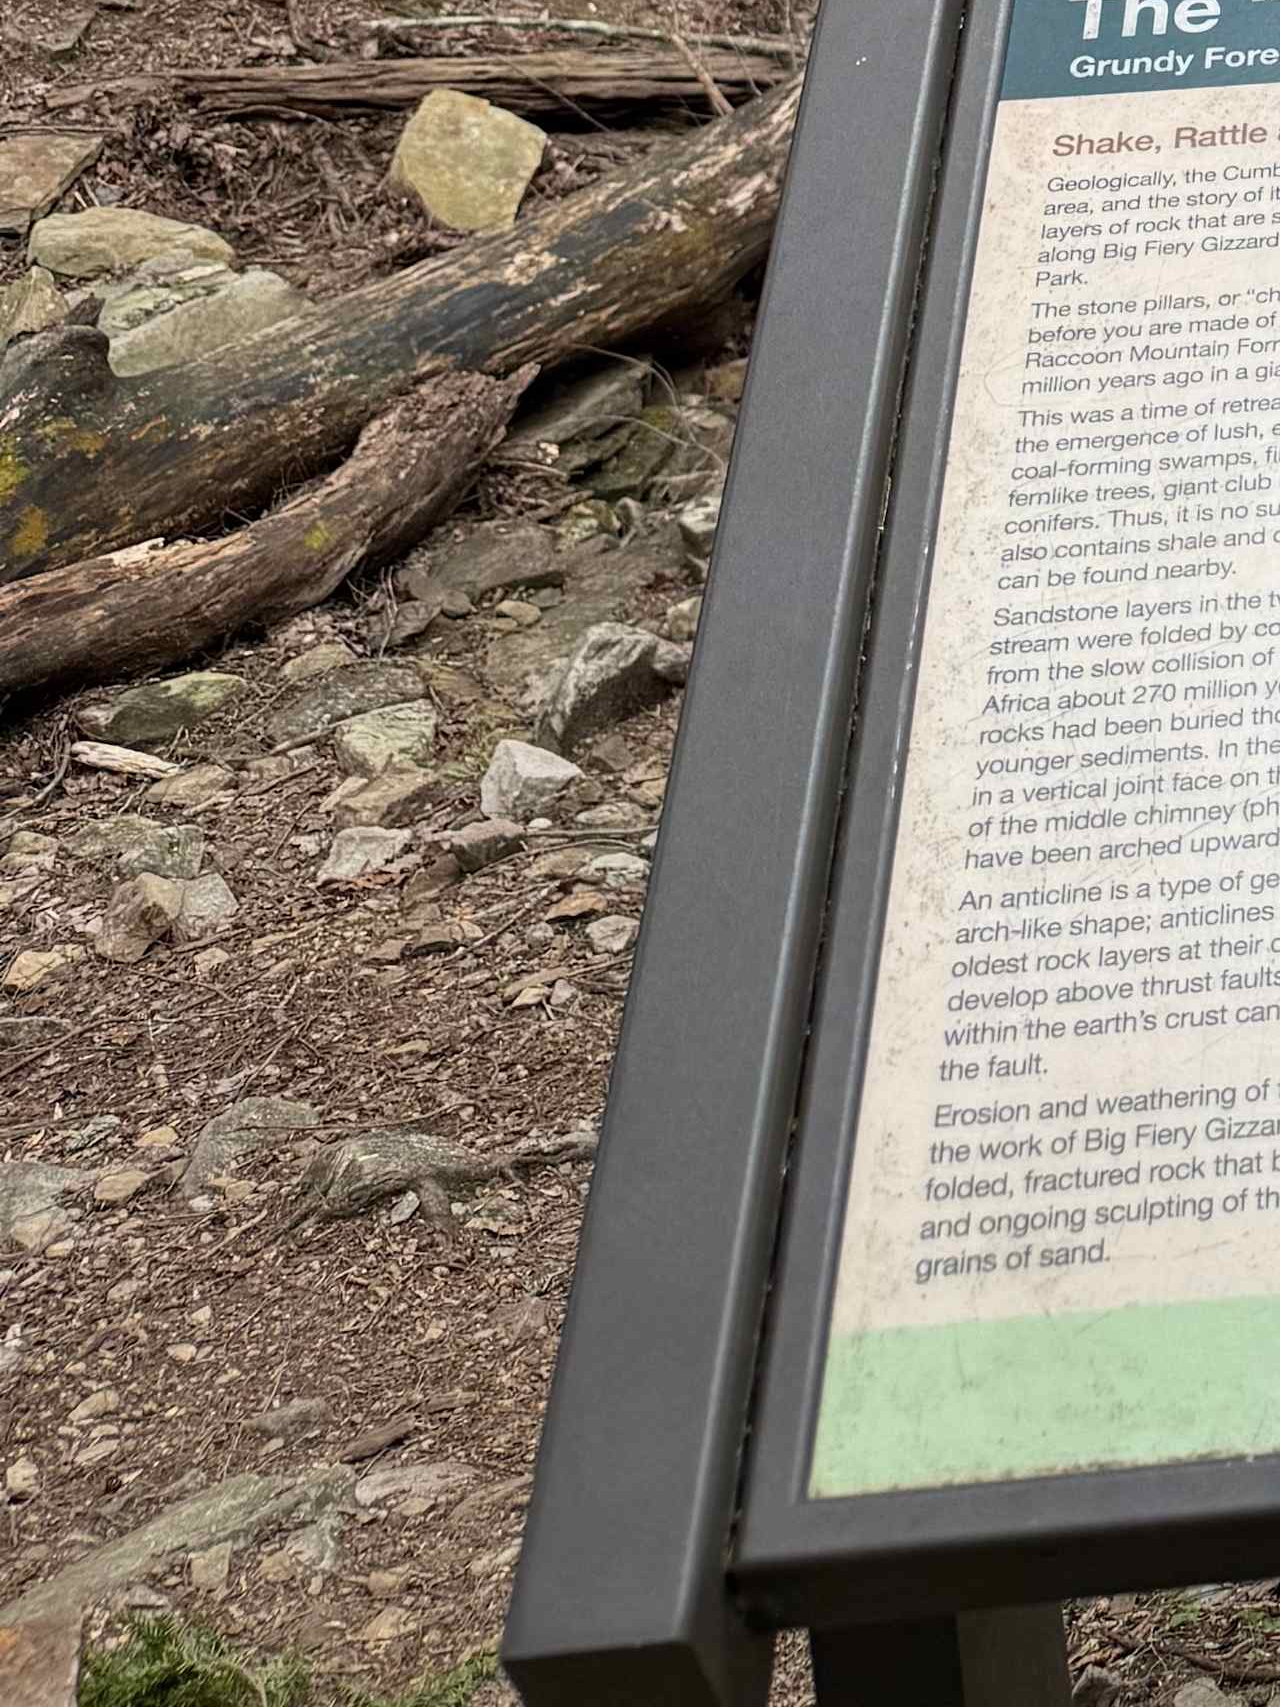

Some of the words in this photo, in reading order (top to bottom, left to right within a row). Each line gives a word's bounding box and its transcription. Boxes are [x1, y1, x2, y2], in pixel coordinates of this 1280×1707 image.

[1068, 49, 1196, 78] Grundy
[1051, 131, 1161, 157] Shake,
[1173, 122, 1268, 149] Rattle
[1046, 170, 1178, 192] Geologically,
[1184, 167, 1217, 183] the
[1036, 246, 1096, 264] along
[1103, 242, 1137, 262] Big
[1143, 239, 1194, 257] Fiery
[1200, 232, 1279, 252] Gizzard
[1034, 269, 1088, 288] Park.
[1023, 349, 1122, 369] Raccoon
[1130, 340, 1229, 362] Mountain
[1017, 408, 1063, 427] This
[1069, 408, 1115, 424] was
[1120, 407, 1135, 421] a
[1140, 402, 1188, 420] time
[1194, 397, 1216, 416] of
[1010, 455, 1153, 481] coal-forming
[1157, 451, 1258, 471] swamps,
[988, 636, 1069, 656] stream
[1077, 632, 1132, 650] were
[1139, 622, 1212, 646] folded
[1218, 621, 1248, 644] by
[980, 694, 1051, 715] Africa
[1056, 688, 1126, 710] about
[1131, 683, 1177, 704] 270
[1184, 679, 1257, 700] million
[978, 723, 1045, 746] rocks
[1052, 718, 1096, 741] had
[1104, 716, 1161, 736] been
[1171, 707, 1244, 732] buried
[954, 917, 1063, 944] arch-like
[1068, 914, 1151, 937] shape;
[1160, 904, 1275, 929] anticlines
[947, 986, 1047, 1012] develop
[1054, 981, 1135, 1004] above
[1141, 972, 1213, 997] thrust
[924, 1172, 1014, 1203] folded,
[1023, 1161, 1141, 1194] fractured
[1148, 1156, 1206, 1183] rock
[1213, 1151, 1264, 1177] that
[915, 1250, 997, 1285] grains
[1005, 1245, 1033, 1270] of
[1038, 1238, 1110, 1267] sand.
